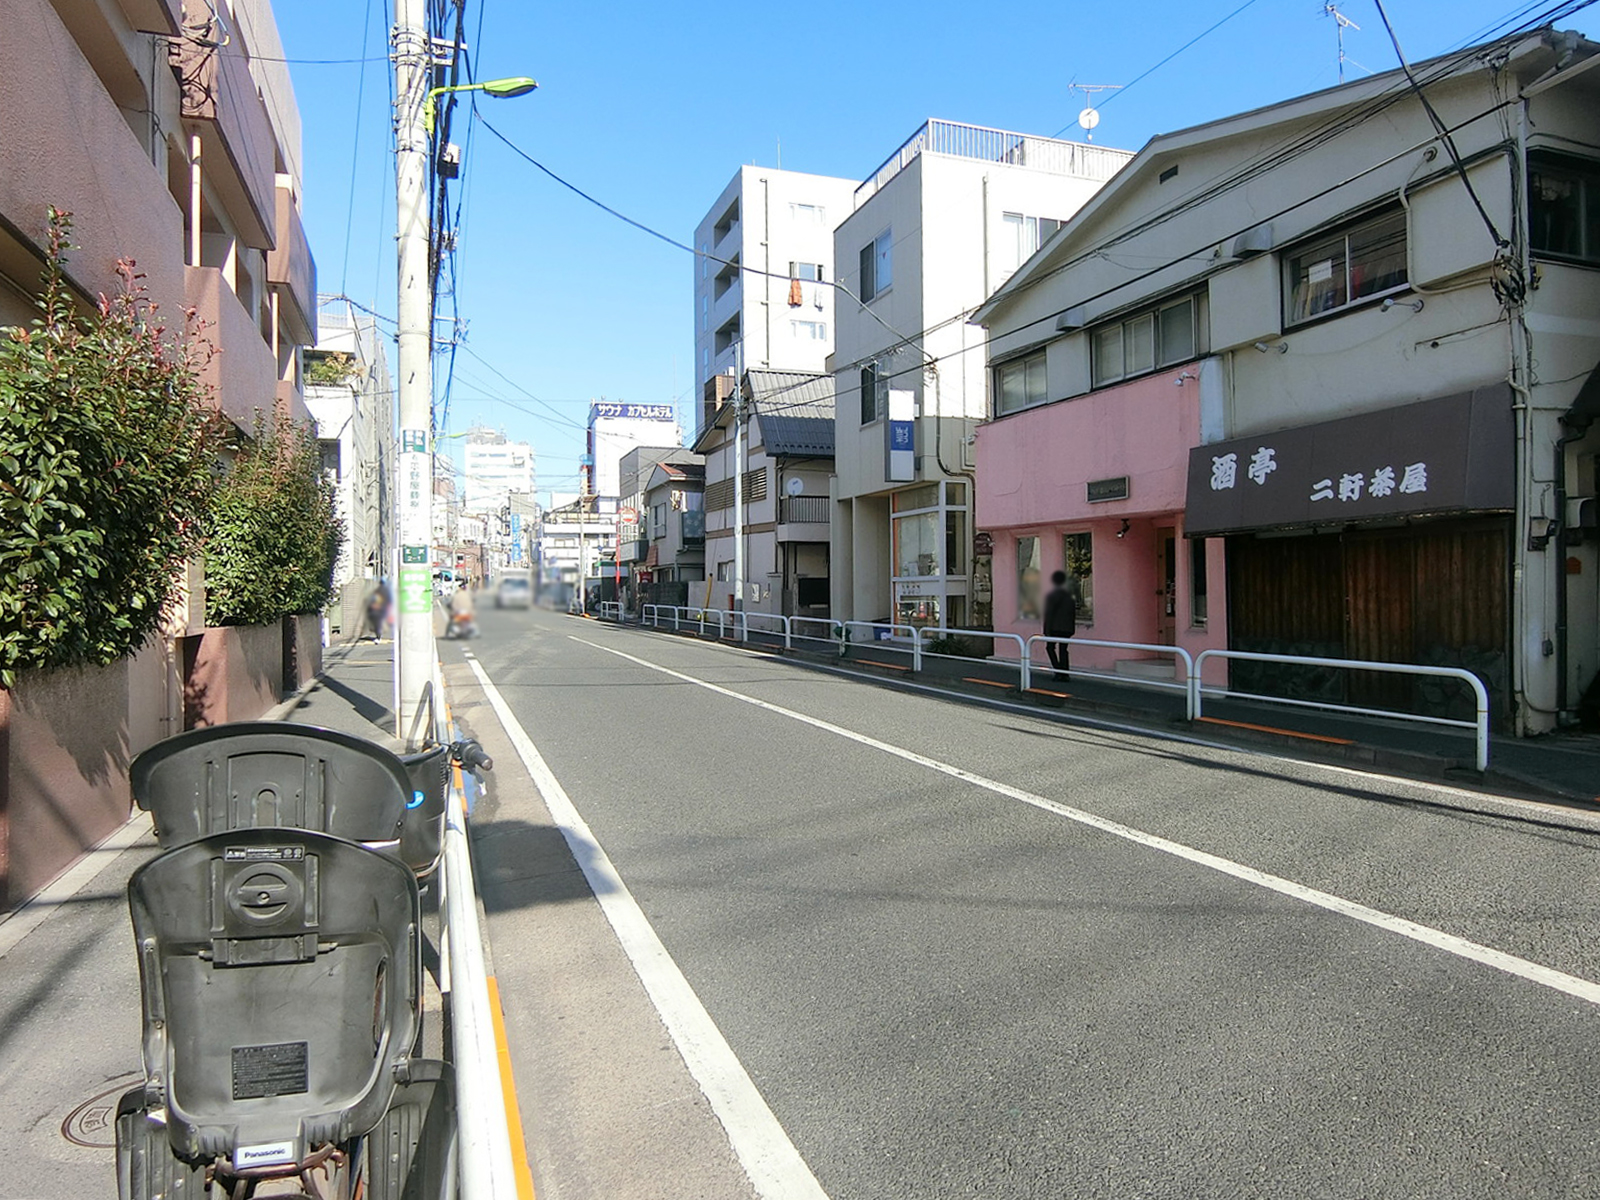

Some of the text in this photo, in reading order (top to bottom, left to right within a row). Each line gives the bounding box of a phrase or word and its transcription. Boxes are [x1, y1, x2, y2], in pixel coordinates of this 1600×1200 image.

[598, 404, 672, 418] サウナ カプセルホテル
[1210, 447, 1277, 491] 酒亭
[1310, 462, 1427, 502] 二軒茶屋
[244, 1148, 286, 1159] Panasonic
